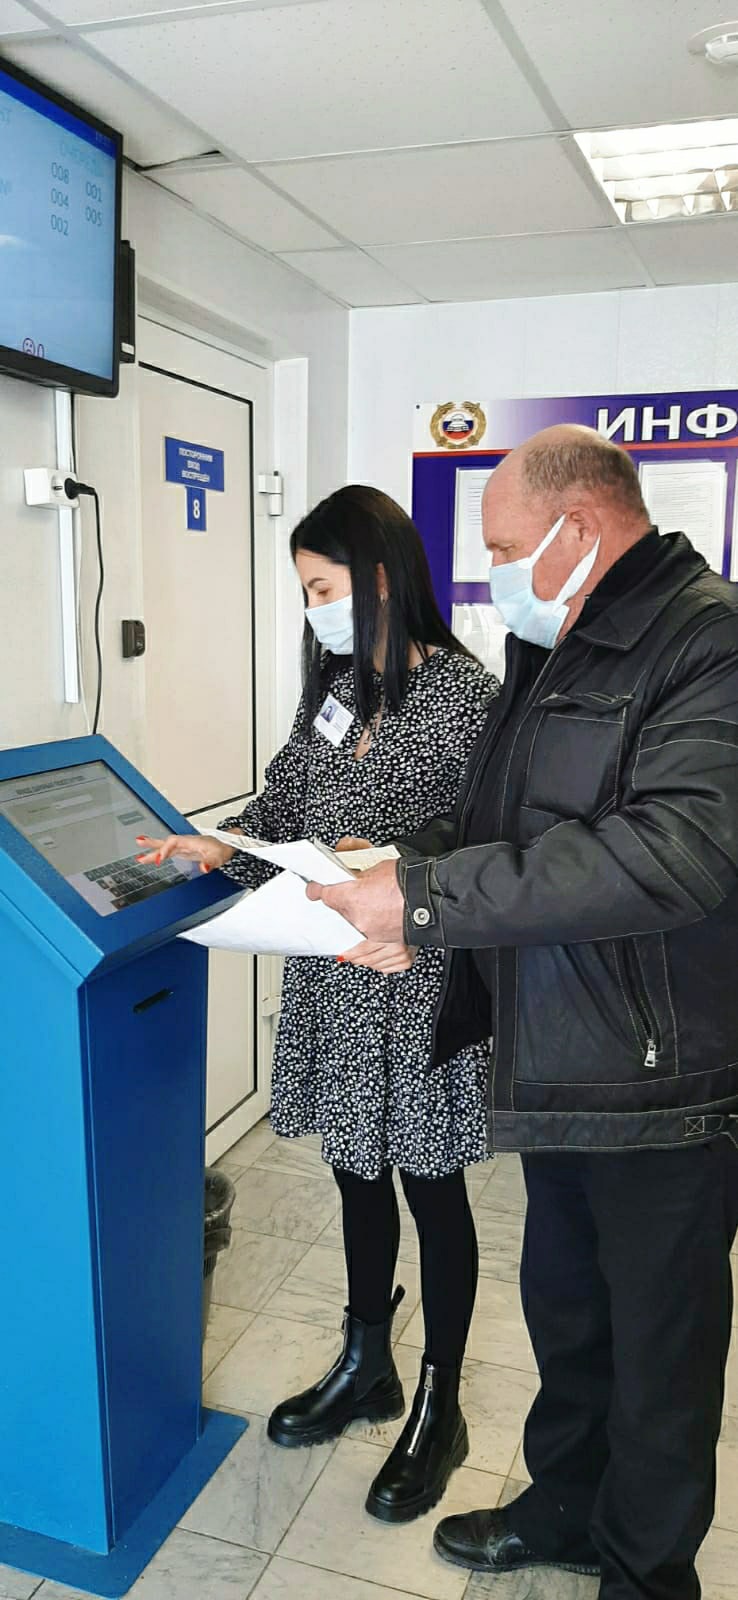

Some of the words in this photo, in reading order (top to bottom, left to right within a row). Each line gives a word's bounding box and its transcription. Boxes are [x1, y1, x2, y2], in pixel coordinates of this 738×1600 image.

[51, 162, 69, 184] 008
[86, 182, 102, 203] 001
[51, 188, 69, 209] 004
[85, 207, 102, 227] 005
[51, 214, 69, 236] 002
[597, 403, 738, 442] ИНФ
[193, 498, 200, 519] 8
